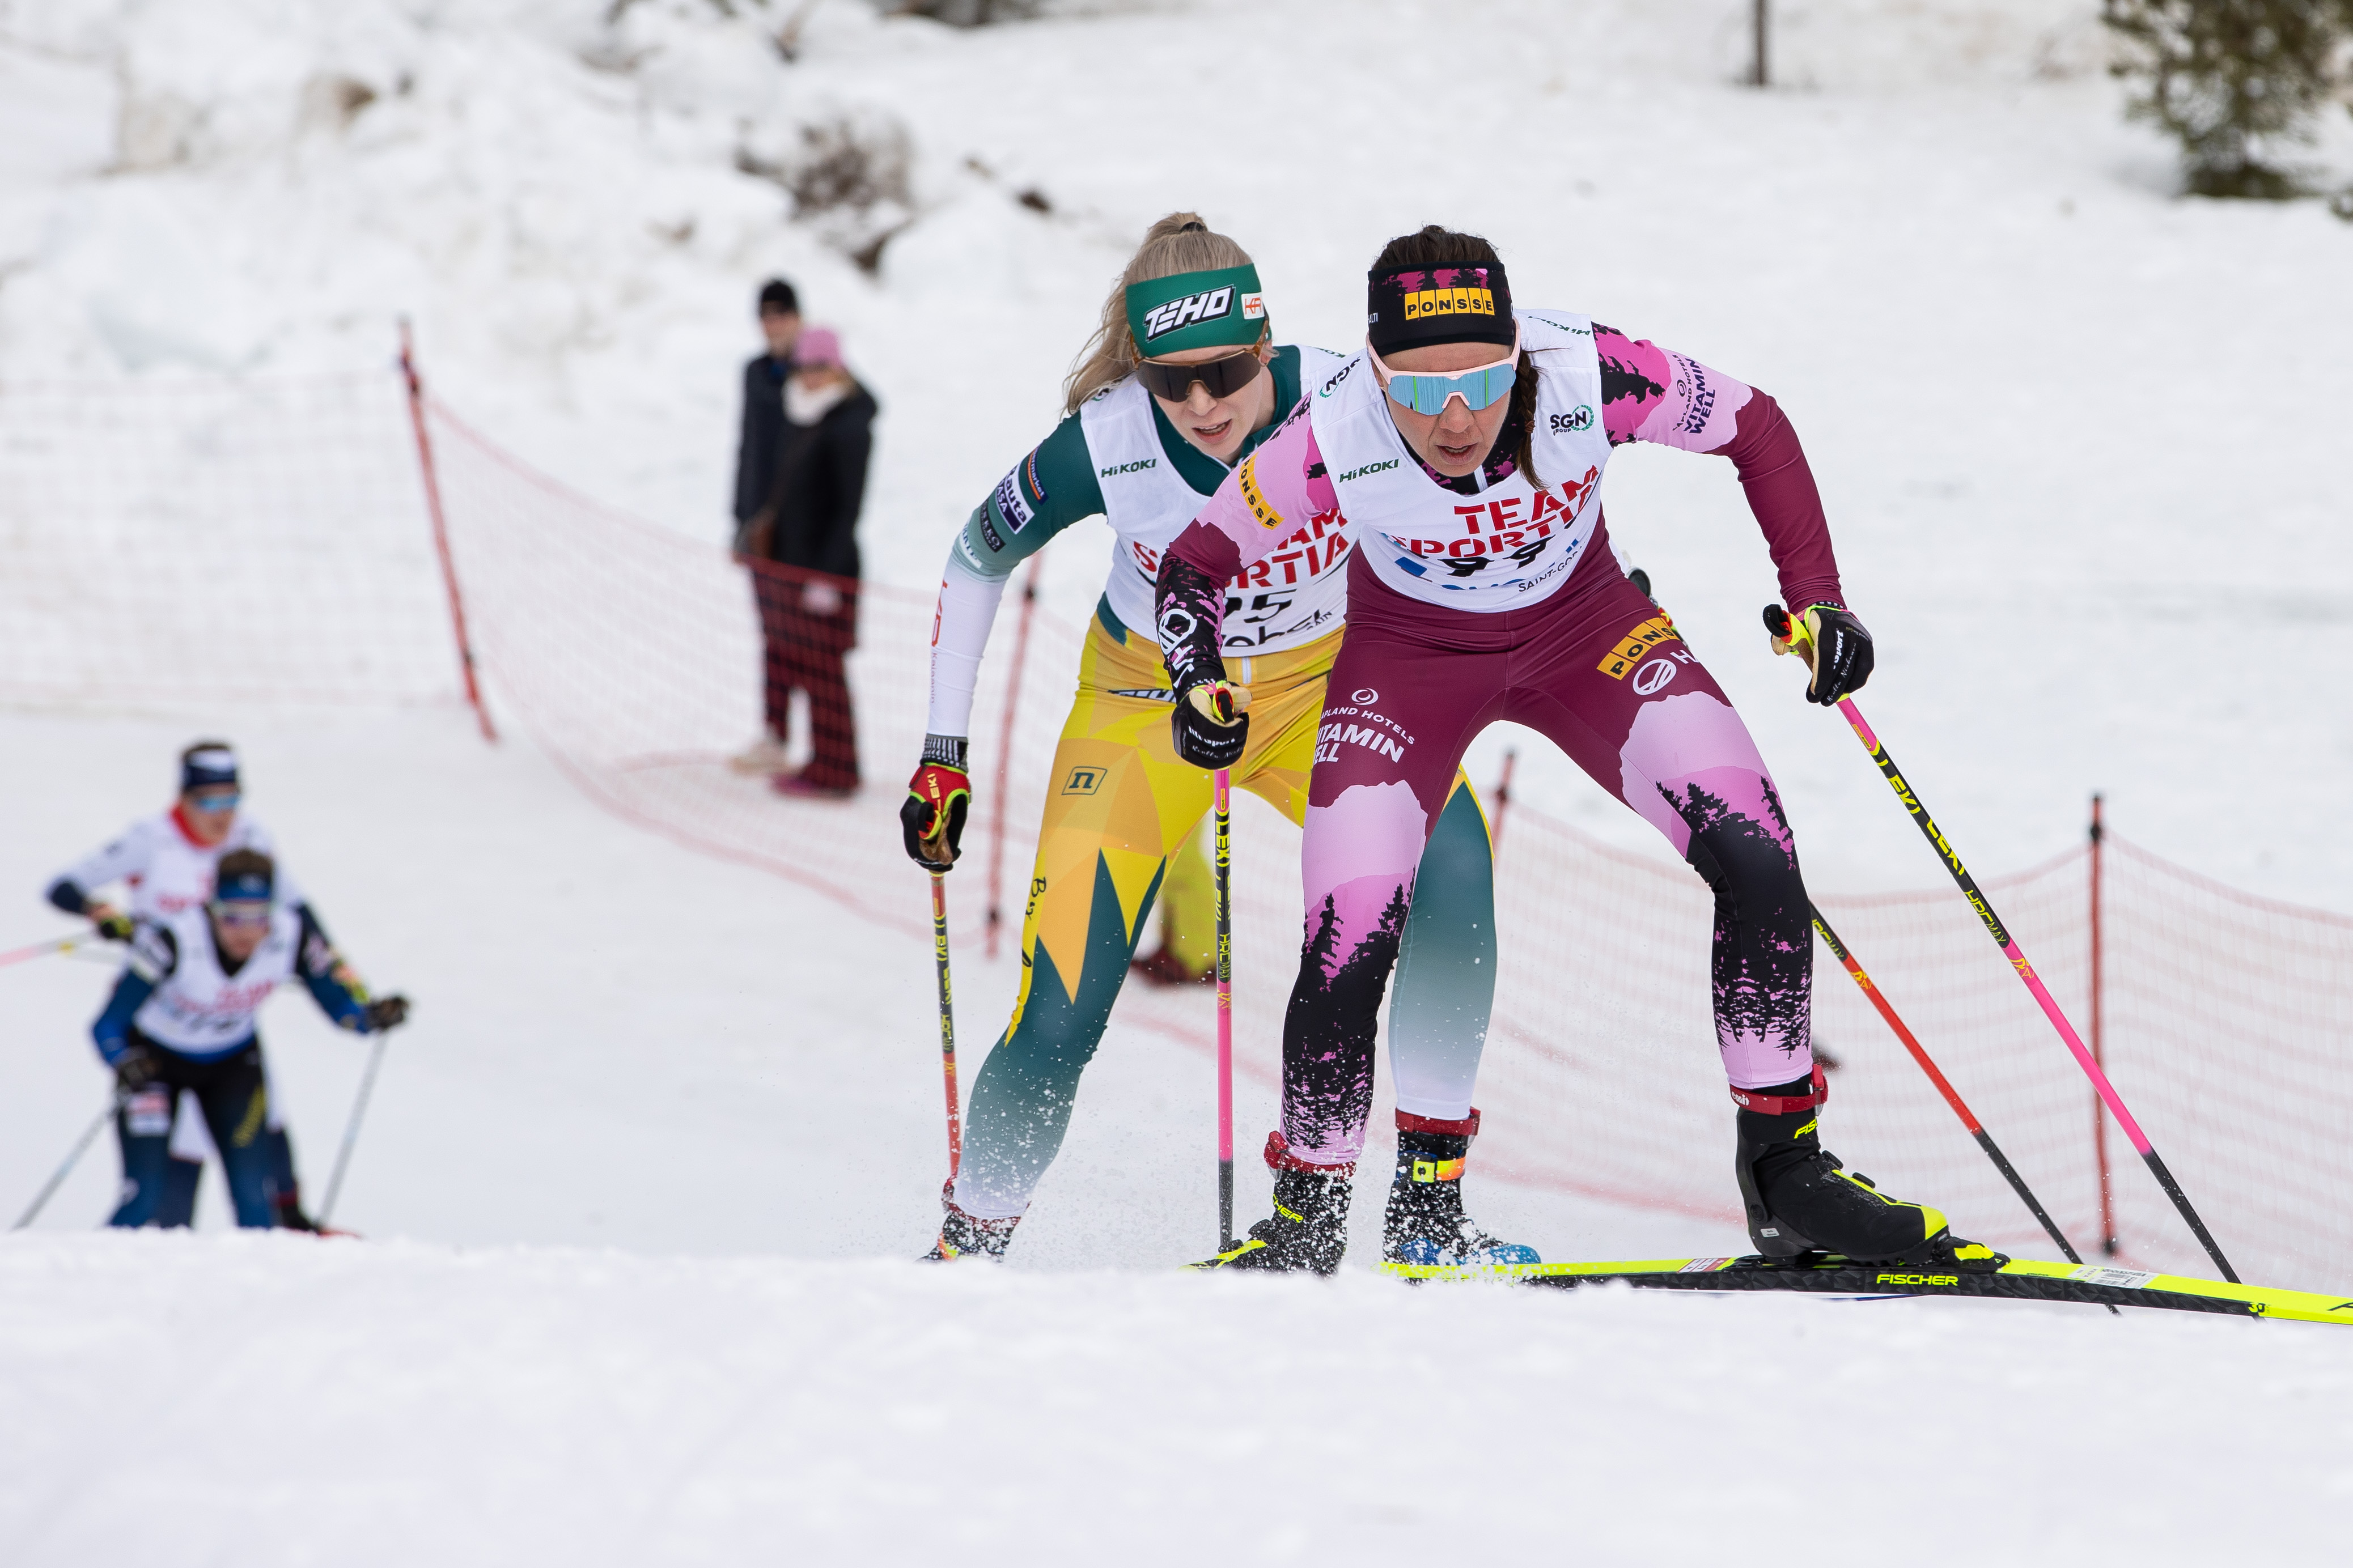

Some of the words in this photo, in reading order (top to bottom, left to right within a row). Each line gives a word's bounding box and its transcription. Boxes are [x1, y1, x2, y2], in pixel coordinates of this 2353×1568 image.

[1144, 285, 1234, 341] TEHO
[1407, 298, 1494, 316] PONSSE
[1683, 358, 1706, 432] VITAMIN
[1689, 389, 1716, 434] WELL
[1550, 411, 1587, 429] SGN
[1101, 458, 1157, 478] HiKOKI
[1339, 458, 1399, 483] HiKOKI
[1453, 465, 1599, 534] TEAM
[1610, 627, 1674, 675] PONS
[1361, 709, 1415, 745] HOTELS
[1216, 818, 1231, 868] LEKI
[1876, 1274, 1958, 1286] FISCHER
